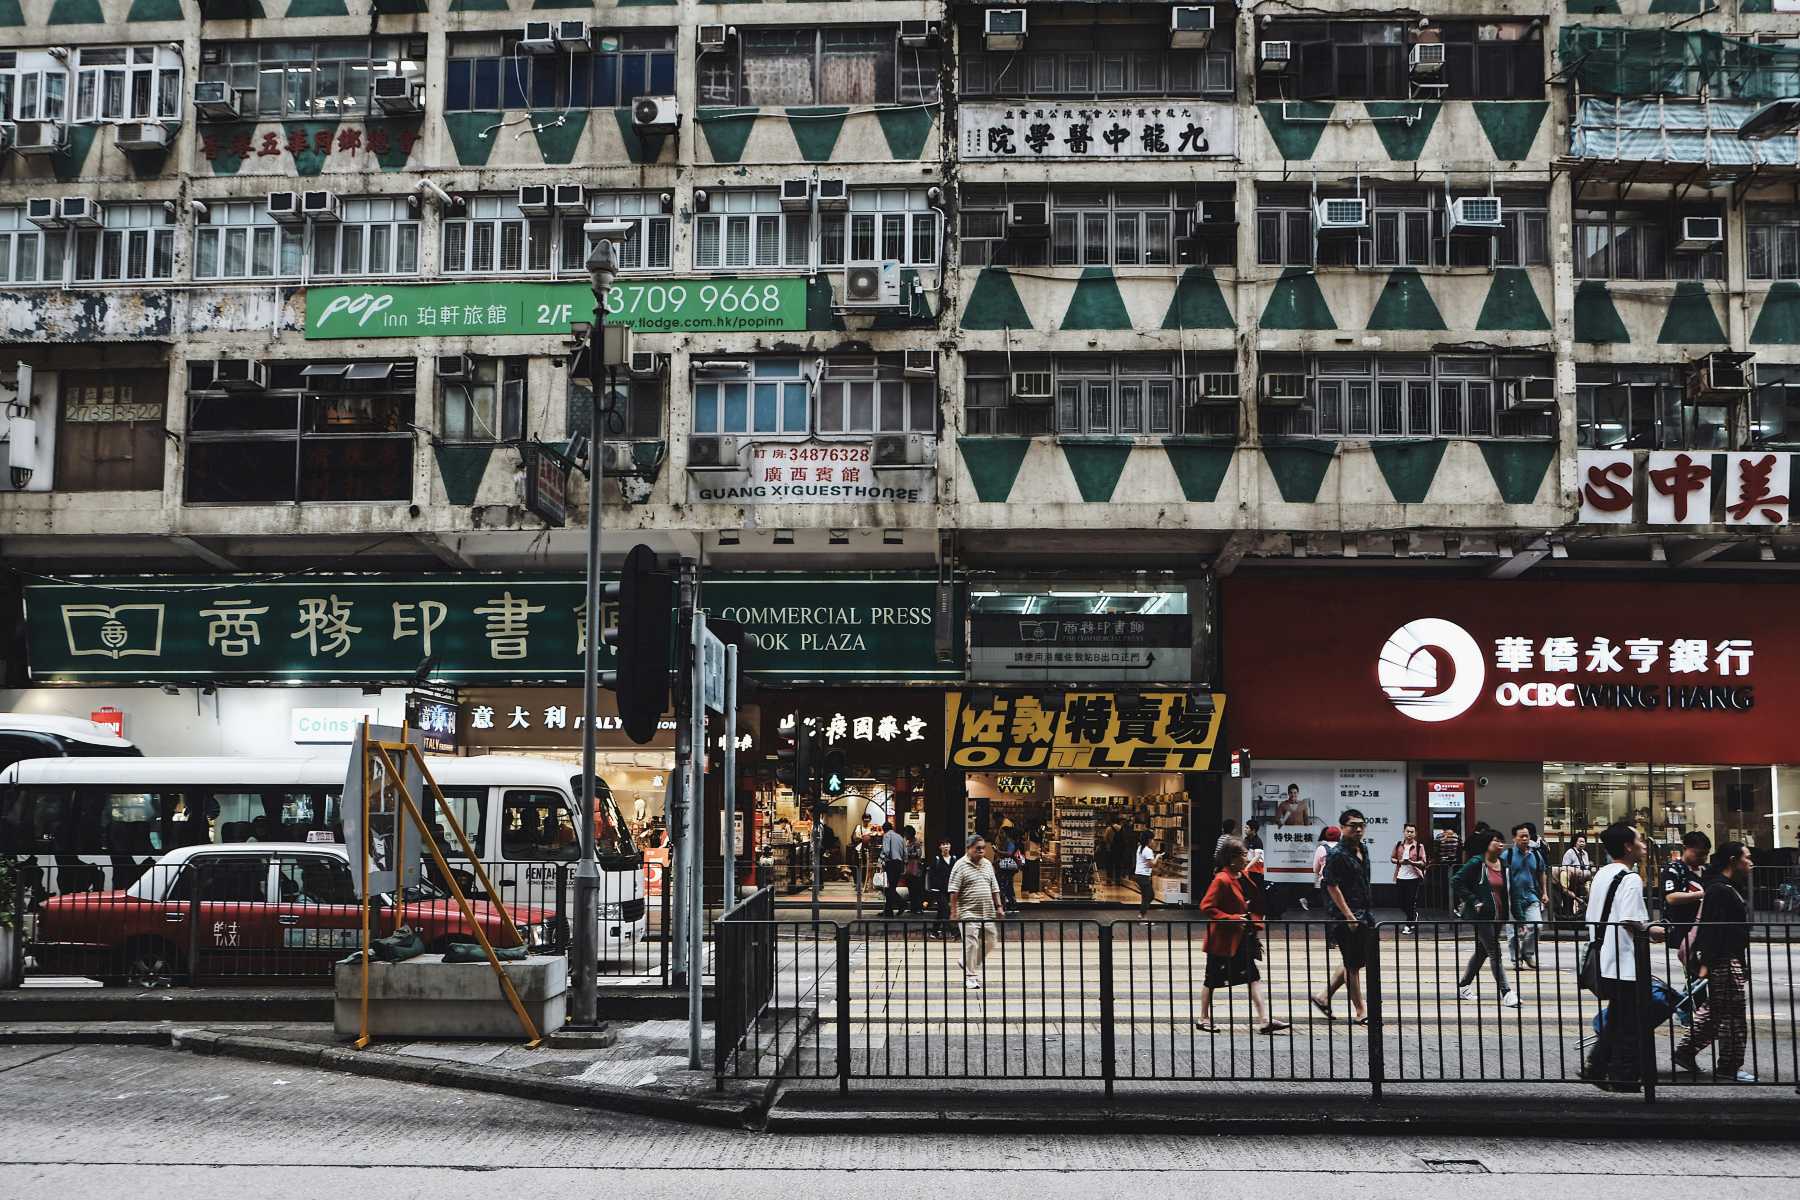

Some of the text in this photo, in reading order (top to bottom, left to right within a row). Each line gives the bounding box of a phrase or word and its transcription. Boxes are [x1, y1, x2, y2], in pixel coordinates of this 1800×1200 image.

[987, 122, 1209, 154] 九龍中醫學院
[606, 284, 780, 314] 3709 9668
[416, 304, 507, 326] 珀軒旅館
[536, 303, 572, 325] 2/F
[789, 447, 869, 462] 34876328
[764, 467, 860, 482] 廣西賓館
[700, 486, 765, 500] GUANG
[722, 607, 862, 625] COMMERCIAL
[871, 608, 932, 625] PRESS
[750, 633, 867, 650] OK PLAZA
[1495, 636, 1754, 676] 華僑永亨銀行
[1495, 682, 1575, 707] OCBC
[1576, 684, 1661, 711] WING
[471, 705, 569, 729] 意大利
[952, 746, 1213, 769] OUTLET
[213, 921, 240, 934] 的士
